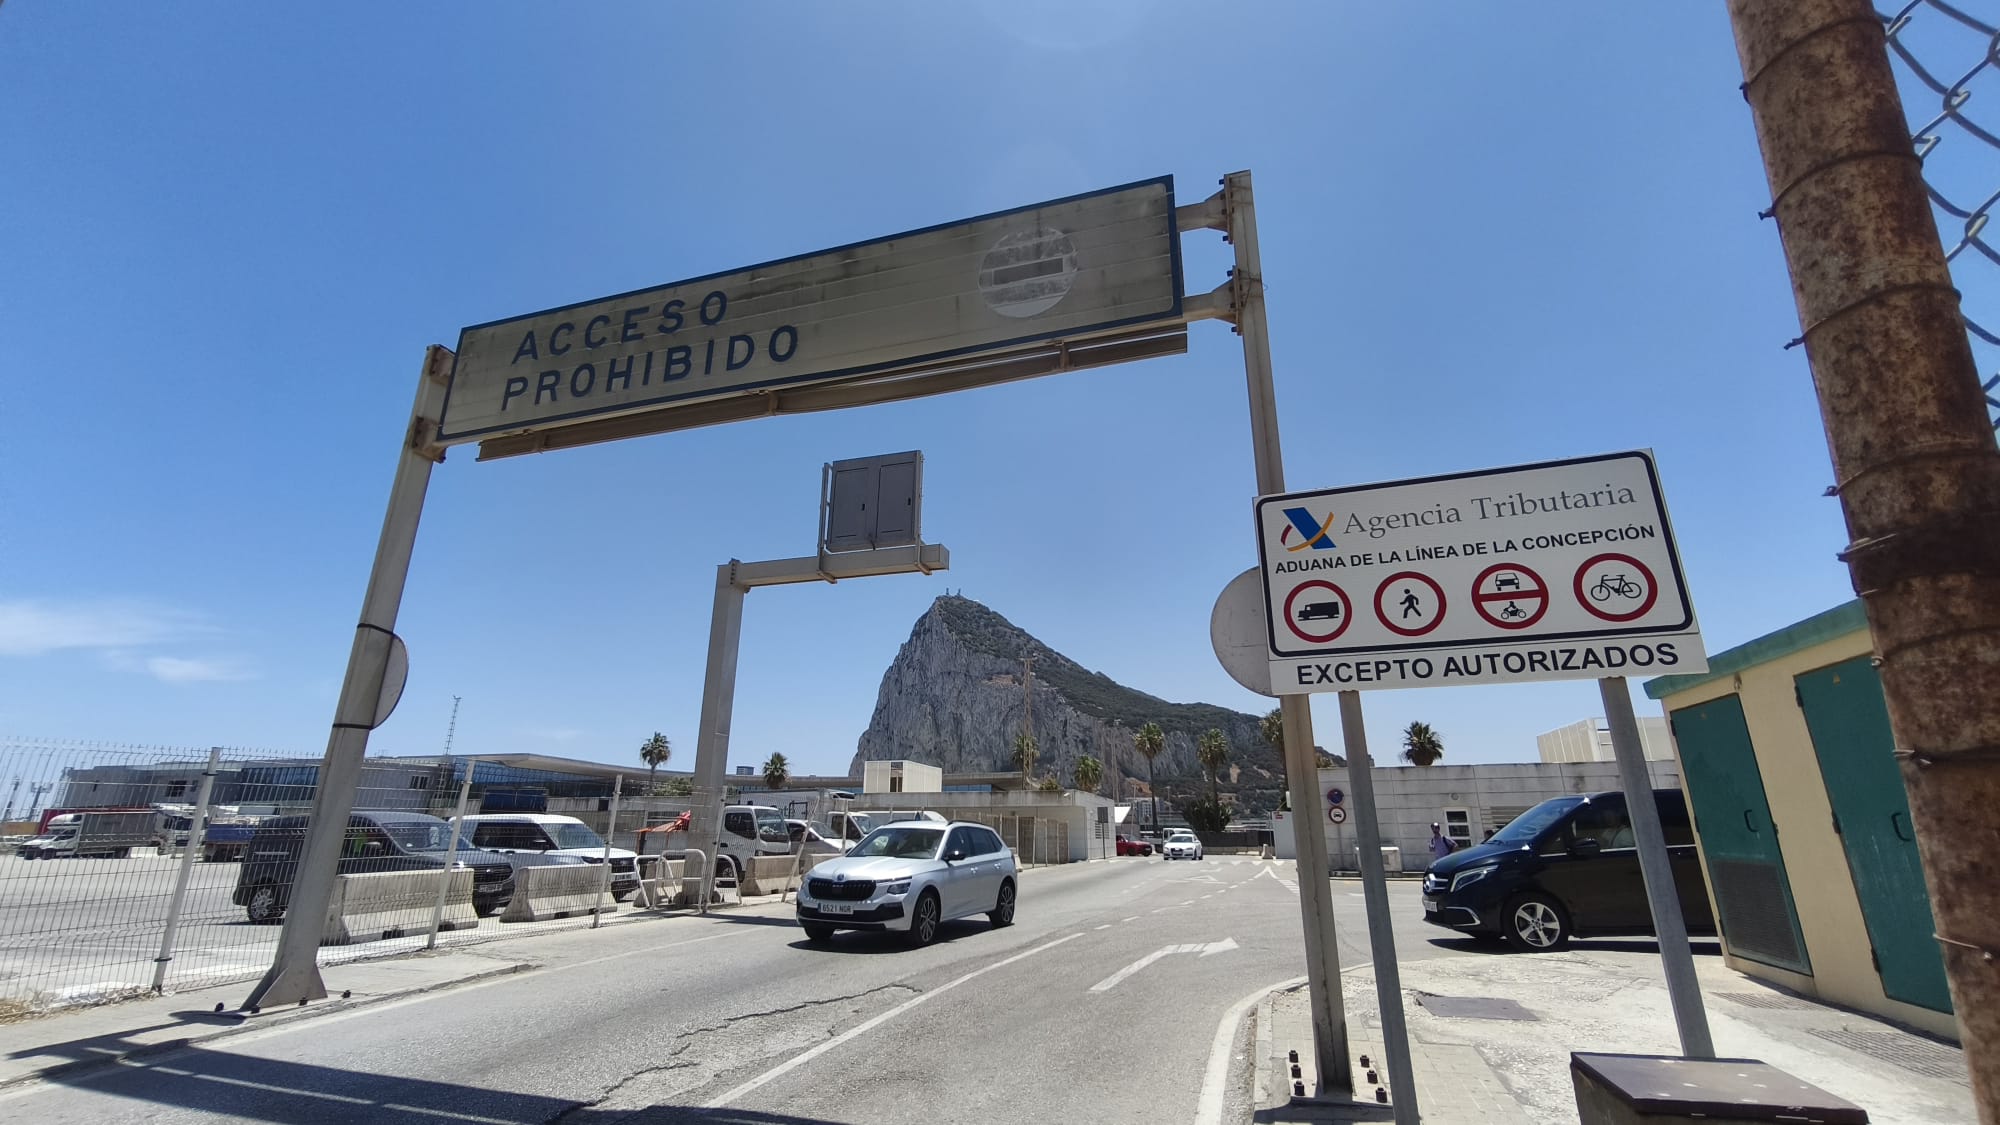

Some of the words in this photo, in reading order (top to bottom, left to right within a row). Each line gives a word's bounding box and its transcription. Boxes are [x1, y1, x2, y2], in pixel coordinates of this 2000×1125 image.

[511, 290, 728, 365] ACCESO
[501, 324, 800, 411] PROHIBIDO
[1343, 504, 1463, 539] Agencia
[1471, 484, 1638, 521] Tributaria
[1275, 555, 1346, 574] ADUANA
[1350, 553, 1374, 567] DE
[1378, 551, 1402, 565] LA
[1406, 545, 1459, 562] LÍNEA
[1463, 542, 1488, 557] DE
[1493, 540, 1518, 554] LA
[1522, 523, 1656, 551] CONCEPCIÓN
[1297, 658, 1433, 685] EXCEPTO
[1443, 643, 1679, 677] AUTORIZADOS
